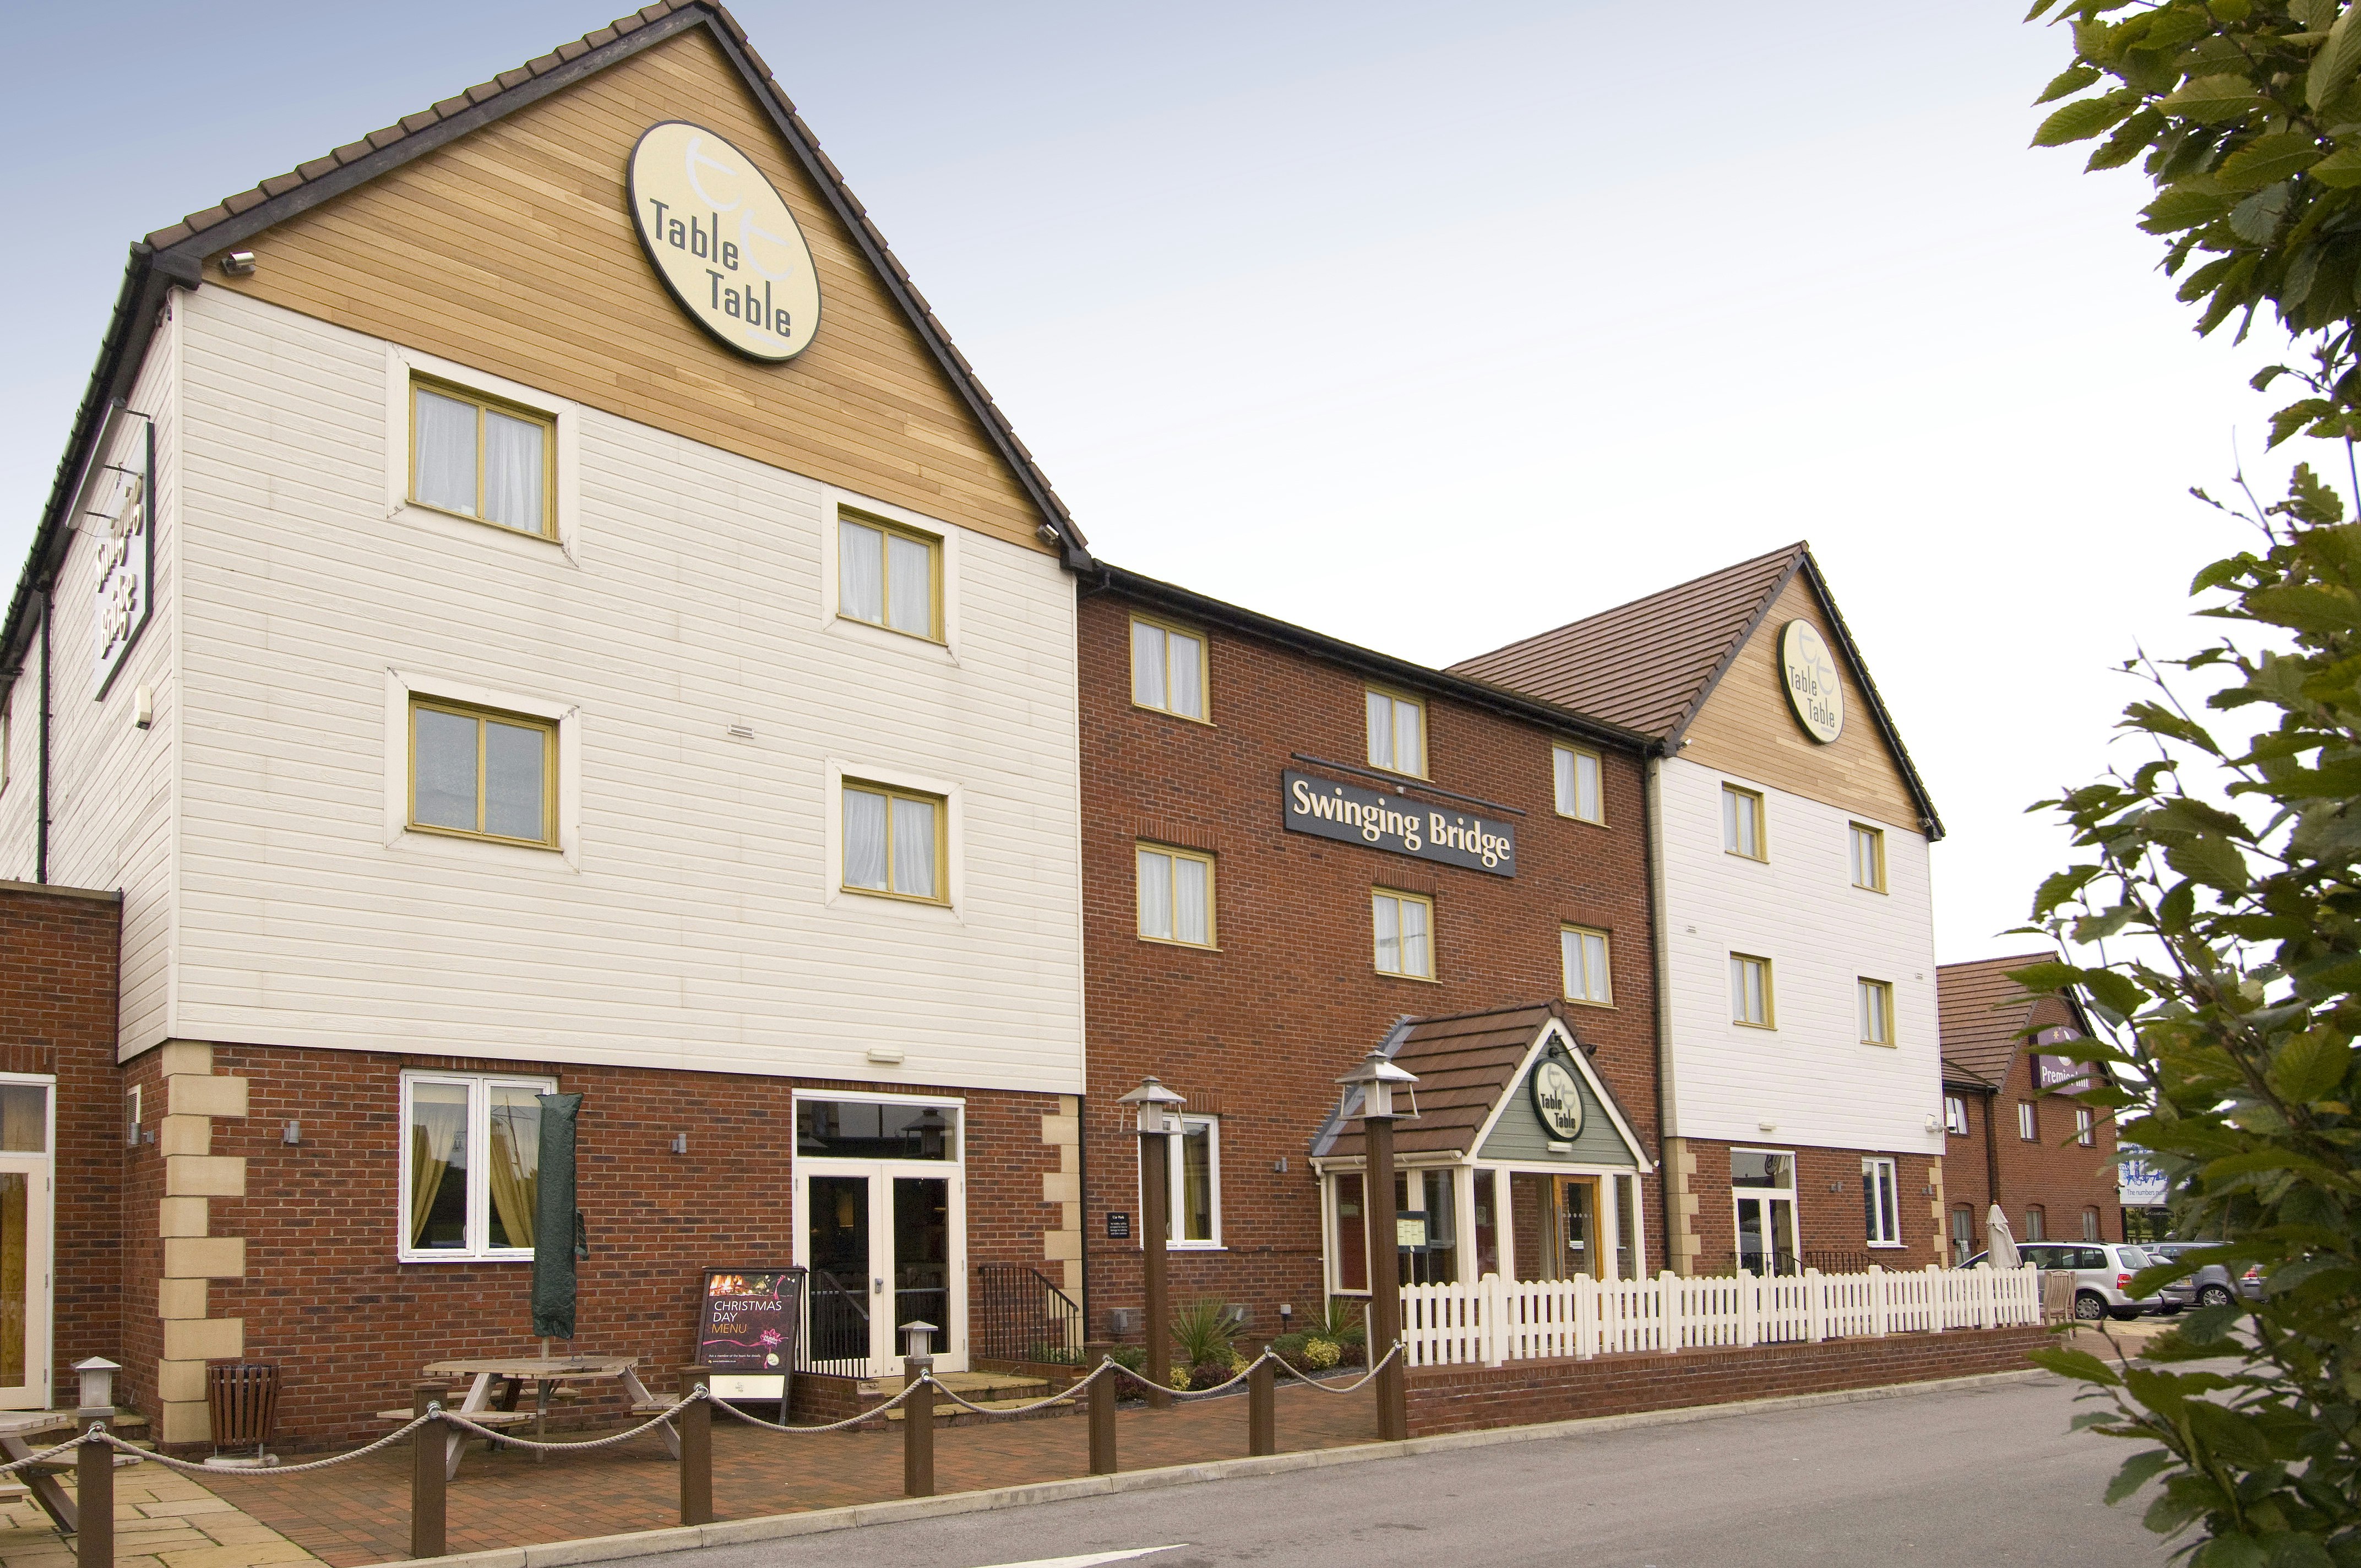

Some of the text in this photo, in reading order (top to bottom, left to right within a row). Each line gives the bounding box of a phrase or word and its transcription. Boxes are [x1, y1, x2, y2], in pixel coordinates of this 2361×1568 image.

[650, 198, 738, 271] Table
[705, 268, 791, 337] Table
[1788, 665, 1818, 696] Table
[1807, 698, 1835, 728] Table
[1291, 780, 1511, 868] Swinging Bridge
[1540, 1090, 1562, 1110] Table
[1554, 1109, 1576, 1129] Table
[713, 1312, 738, 1322] DAY
[714, 1300, 782, 1311] CHRISTMAS
[712, 1324, 747, 1333] MENU
